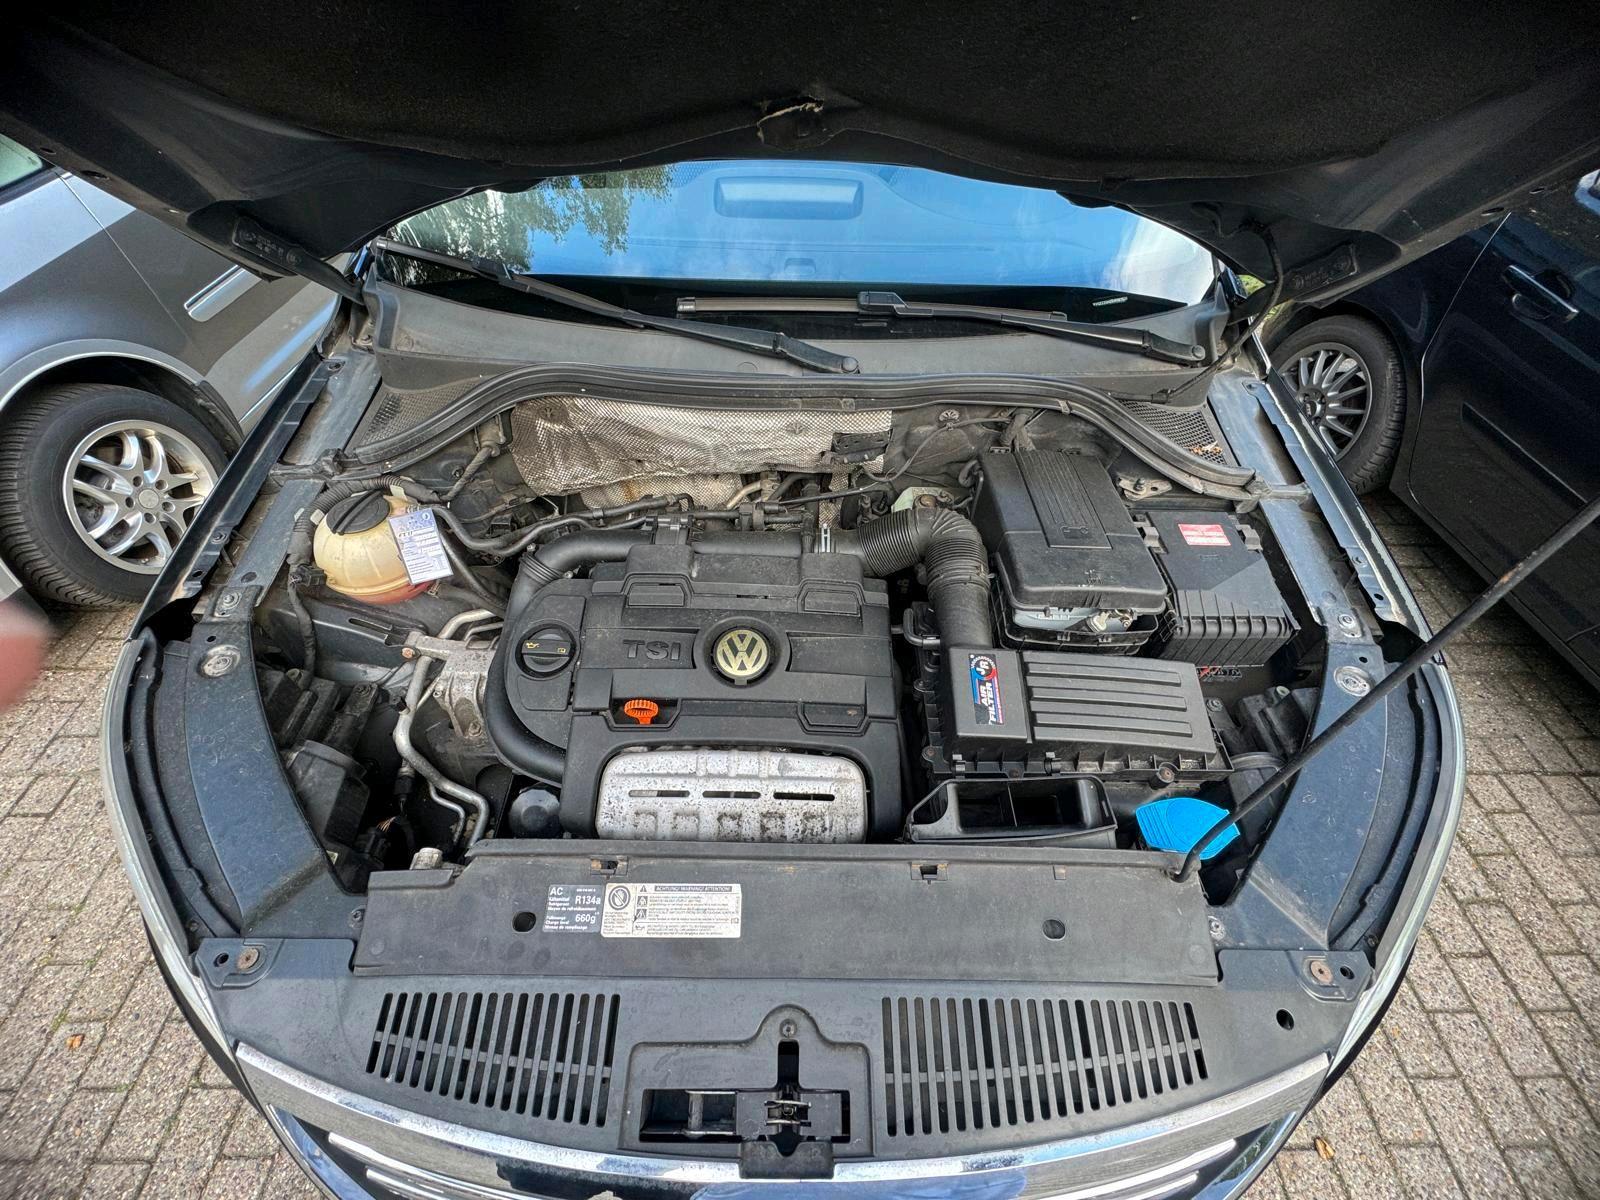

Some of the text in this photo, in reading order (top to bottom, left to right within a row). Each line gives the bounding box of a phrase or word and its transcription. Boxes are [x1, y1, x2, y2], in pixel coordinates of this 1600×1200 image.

[623, 639, 682, 661] TSI
[980, 685, 989, 706] AIR
[985, 682, 997, 724] FILTER
[550, 887, 563, 896] AC
[575, 895, 601, 905] R134a
[575, 914, 596, 924] 660g
